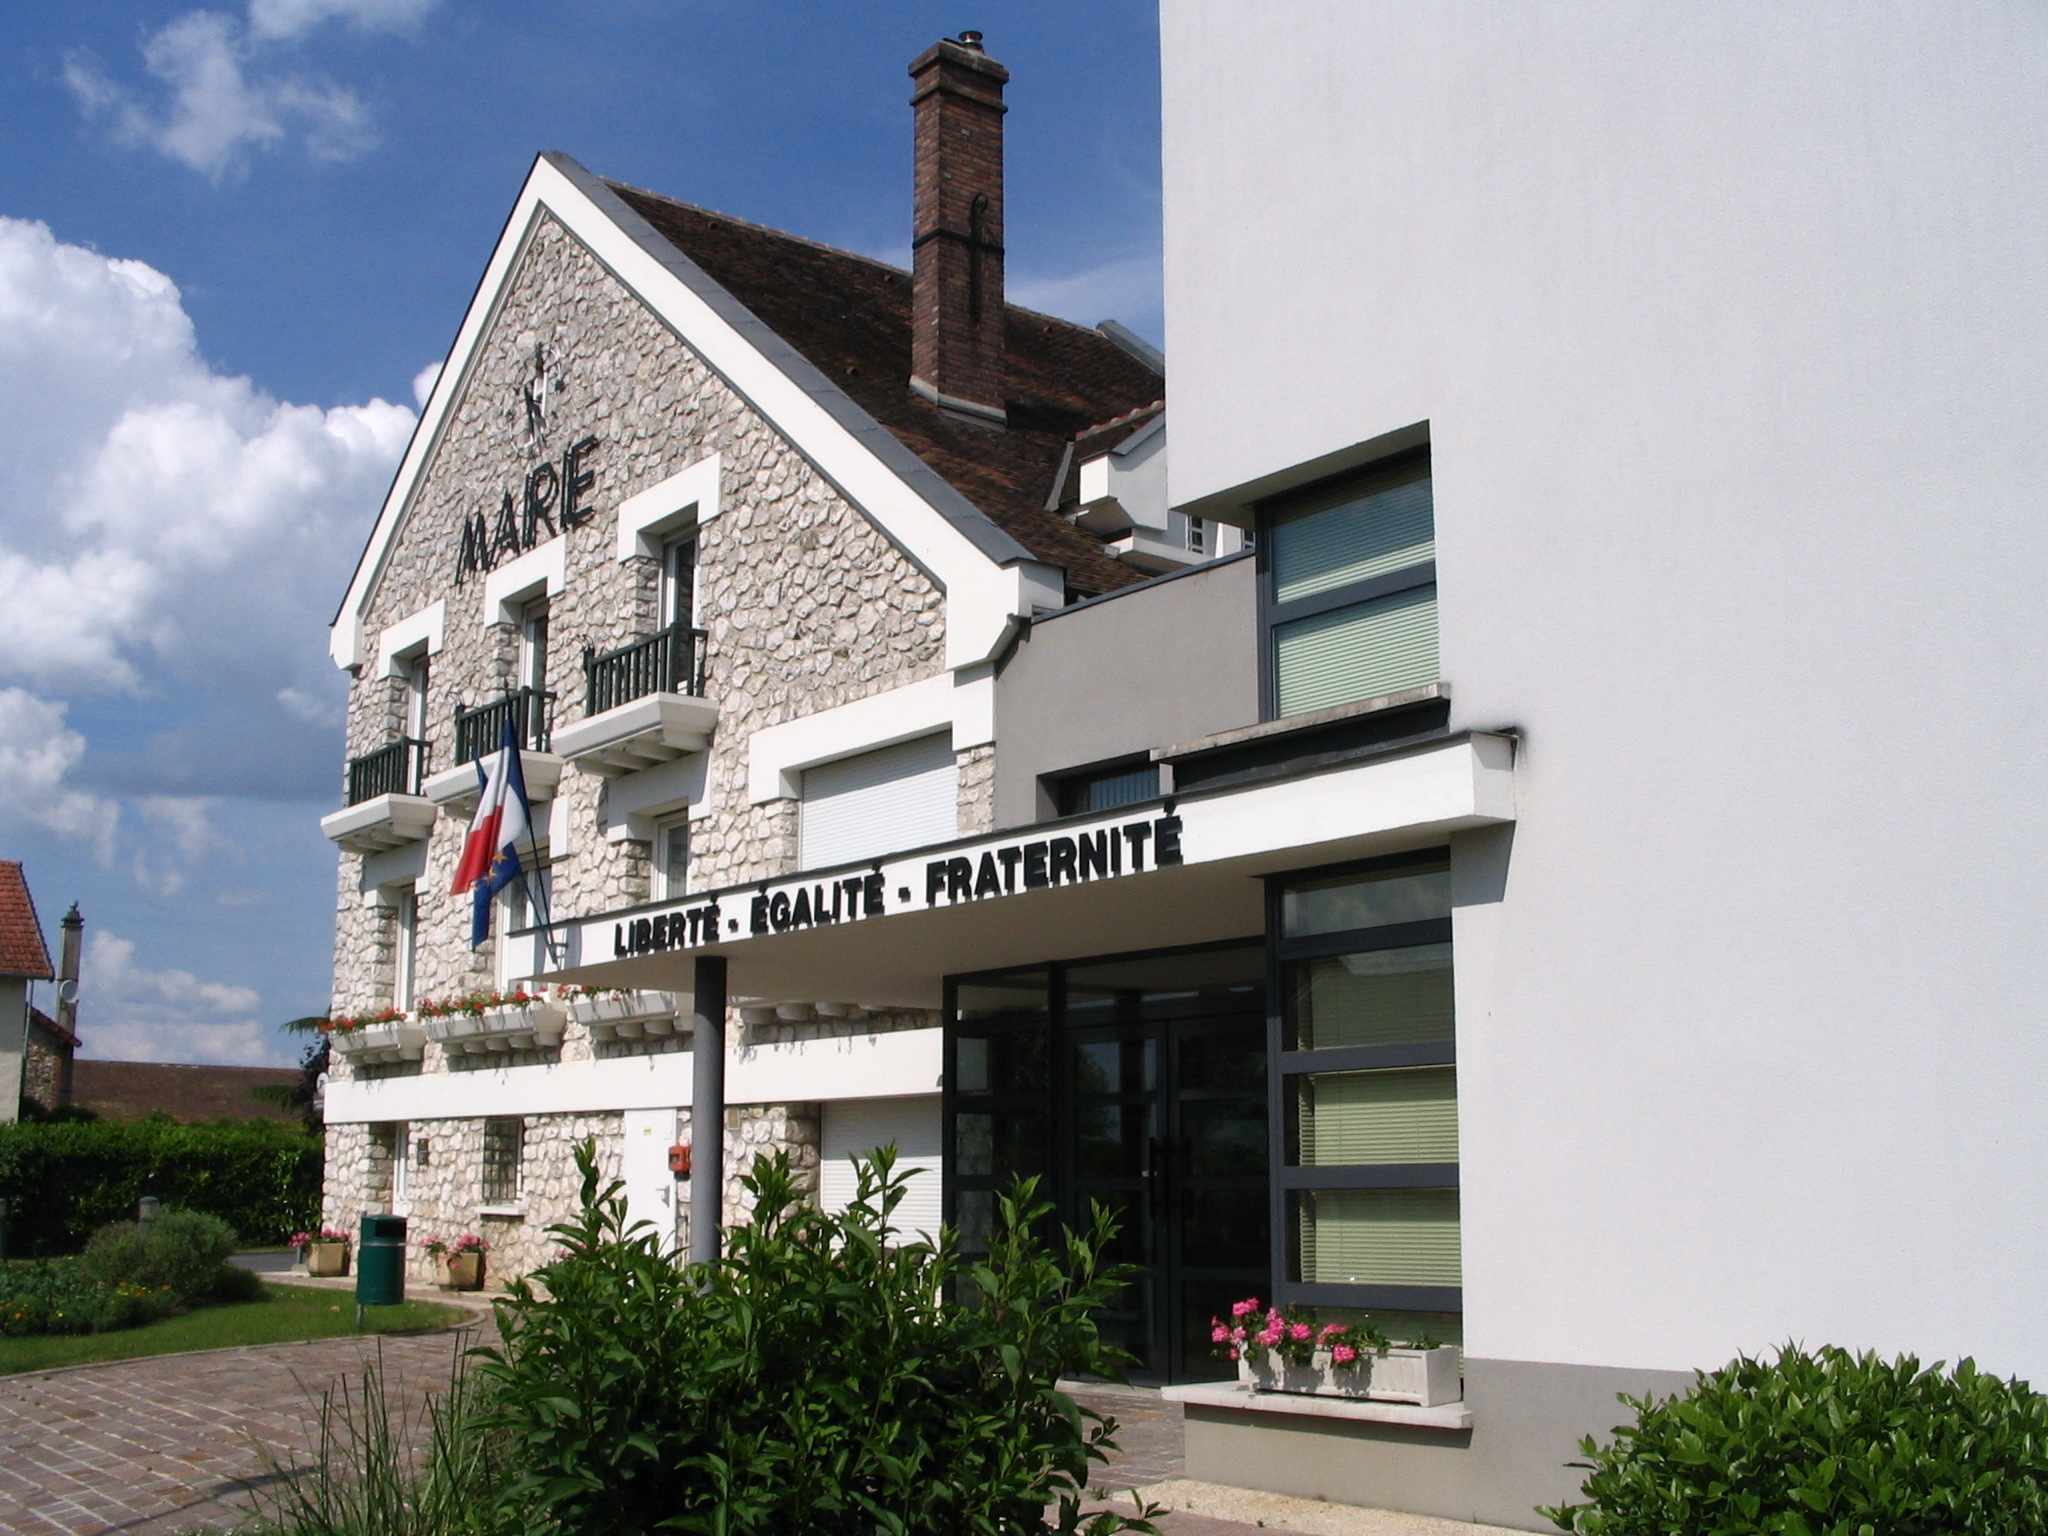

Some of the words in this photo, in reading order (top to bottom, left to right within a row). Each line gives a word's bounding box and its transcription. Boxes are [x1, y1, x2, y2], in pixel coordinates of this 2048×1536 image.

[614, 893, 721, 957] LIBERTÉ
[750, 862, 885, 934] ÉGALITÉ
[925, 801, 1183, 906] FRATERNITÉ
